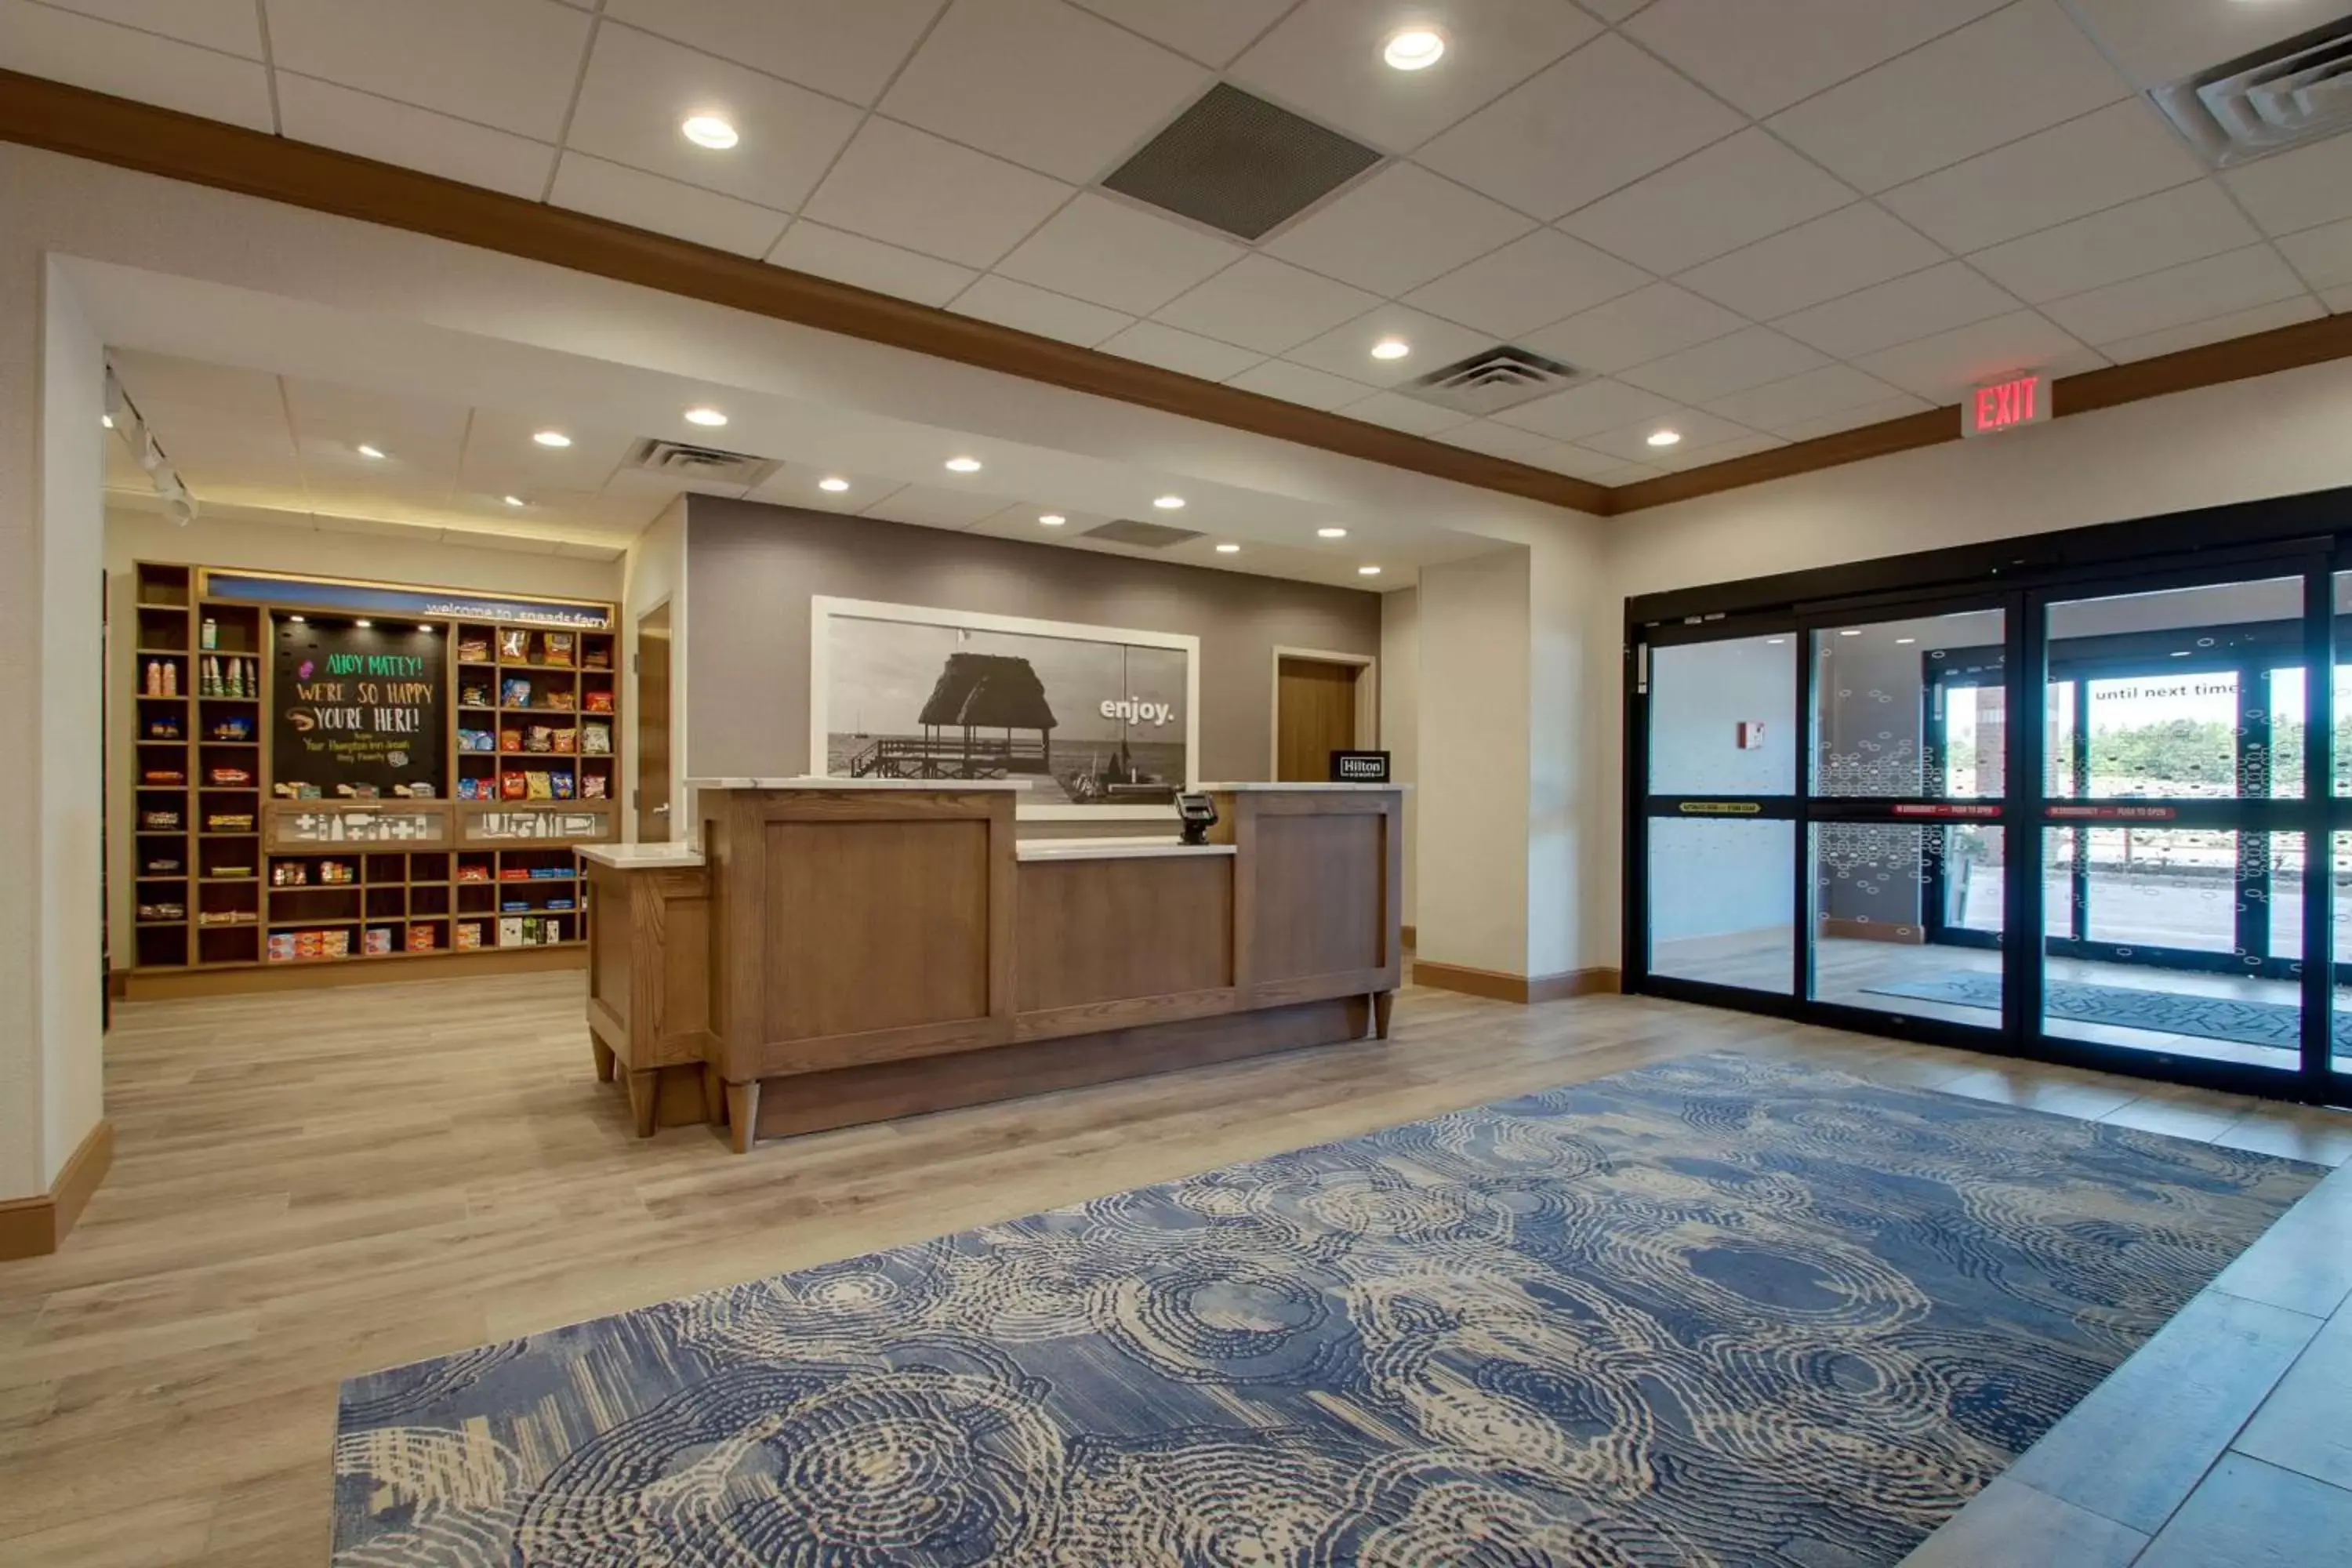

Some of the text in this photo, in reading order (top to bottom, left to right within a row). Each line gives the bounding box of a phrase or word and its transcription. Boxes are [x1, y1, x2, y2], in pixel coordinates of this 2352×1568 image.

[1977, 376, 2038, 430] EXIT
[425, 602, 492, 617] welcome
[326, 653, 425, 677] AHOY MATEY!
[357, 682, 379, 704] SO
[386, 683, 434, 705] HAPPY
[2095, 687, 2139, 701] until
[2144, 684, 2187, 698] next
[373, 708, 421, 733] HERE!
[1100, 695, 1174, 726] enjoy.
[1345, 760, 1381, 771] Hilton
